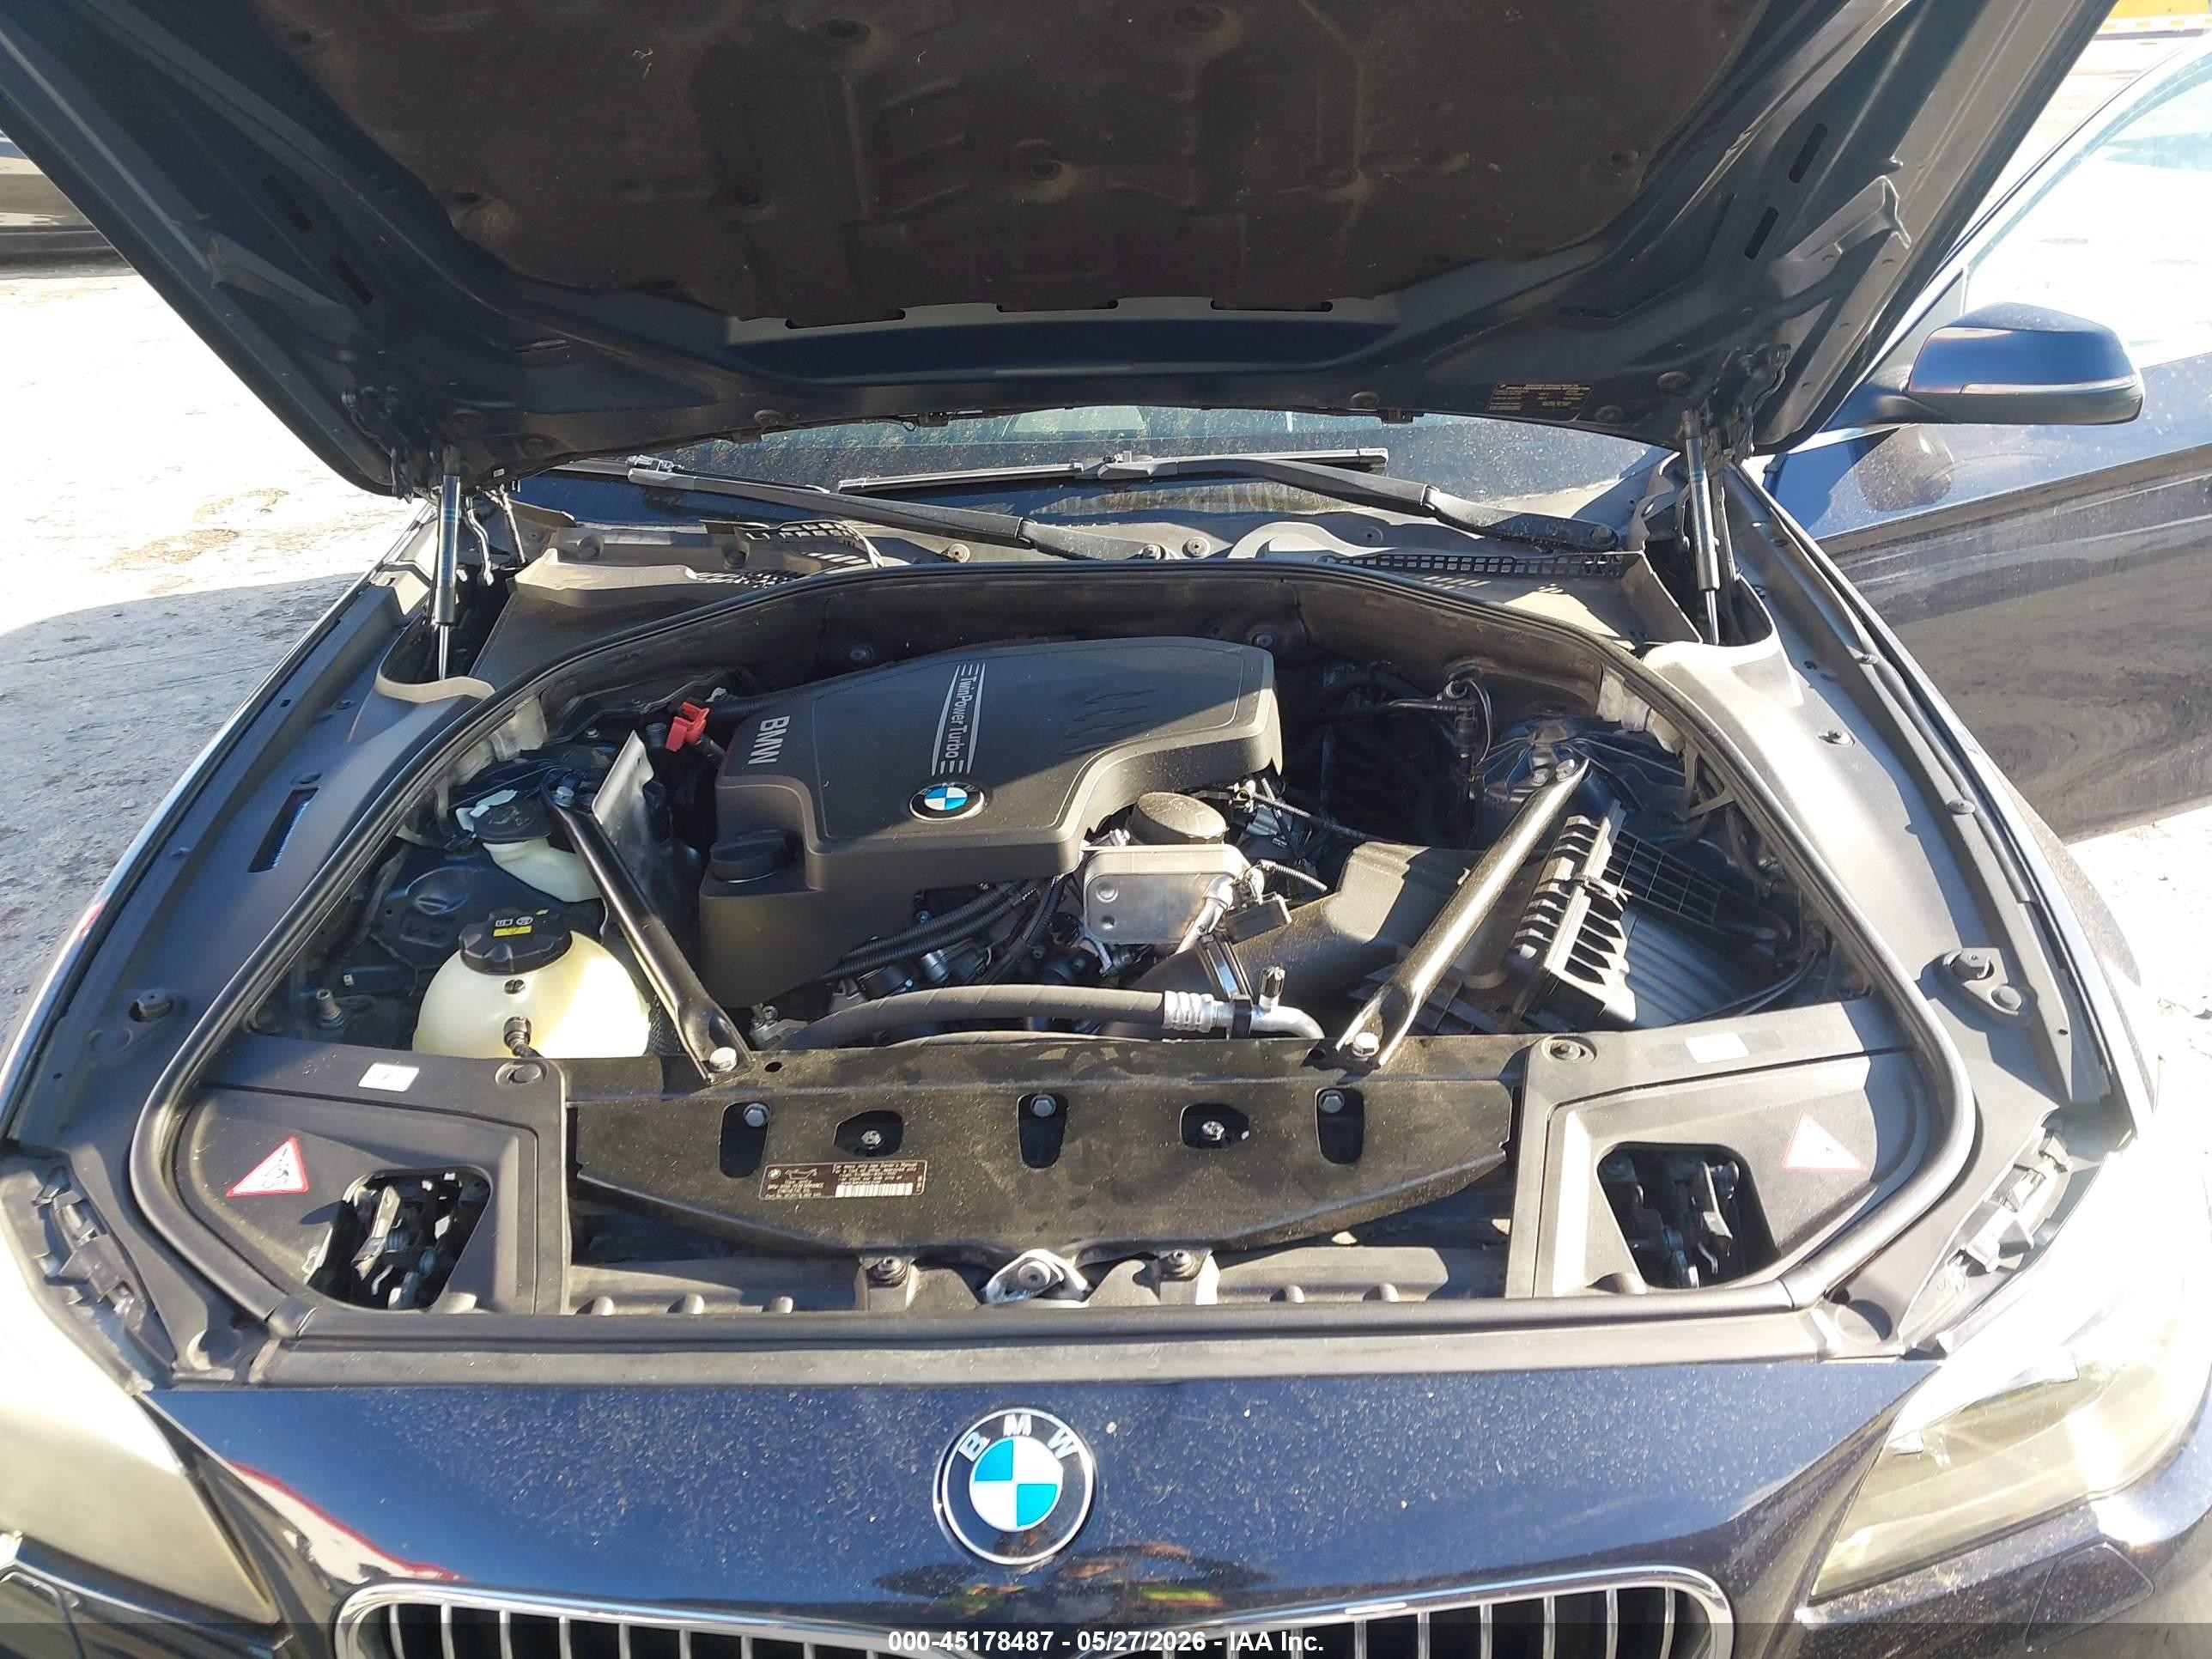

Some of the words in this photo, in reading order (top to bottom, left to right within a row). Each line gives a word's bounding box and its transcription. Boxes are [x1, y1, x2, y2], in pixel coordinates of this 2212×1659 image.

[951, 676, 977, 725] TwinPower
[747, 715, 790, 764] BMW
[945, 725, 968, 758] Turbo
[957, 1413, 1079, 1462] BMW
